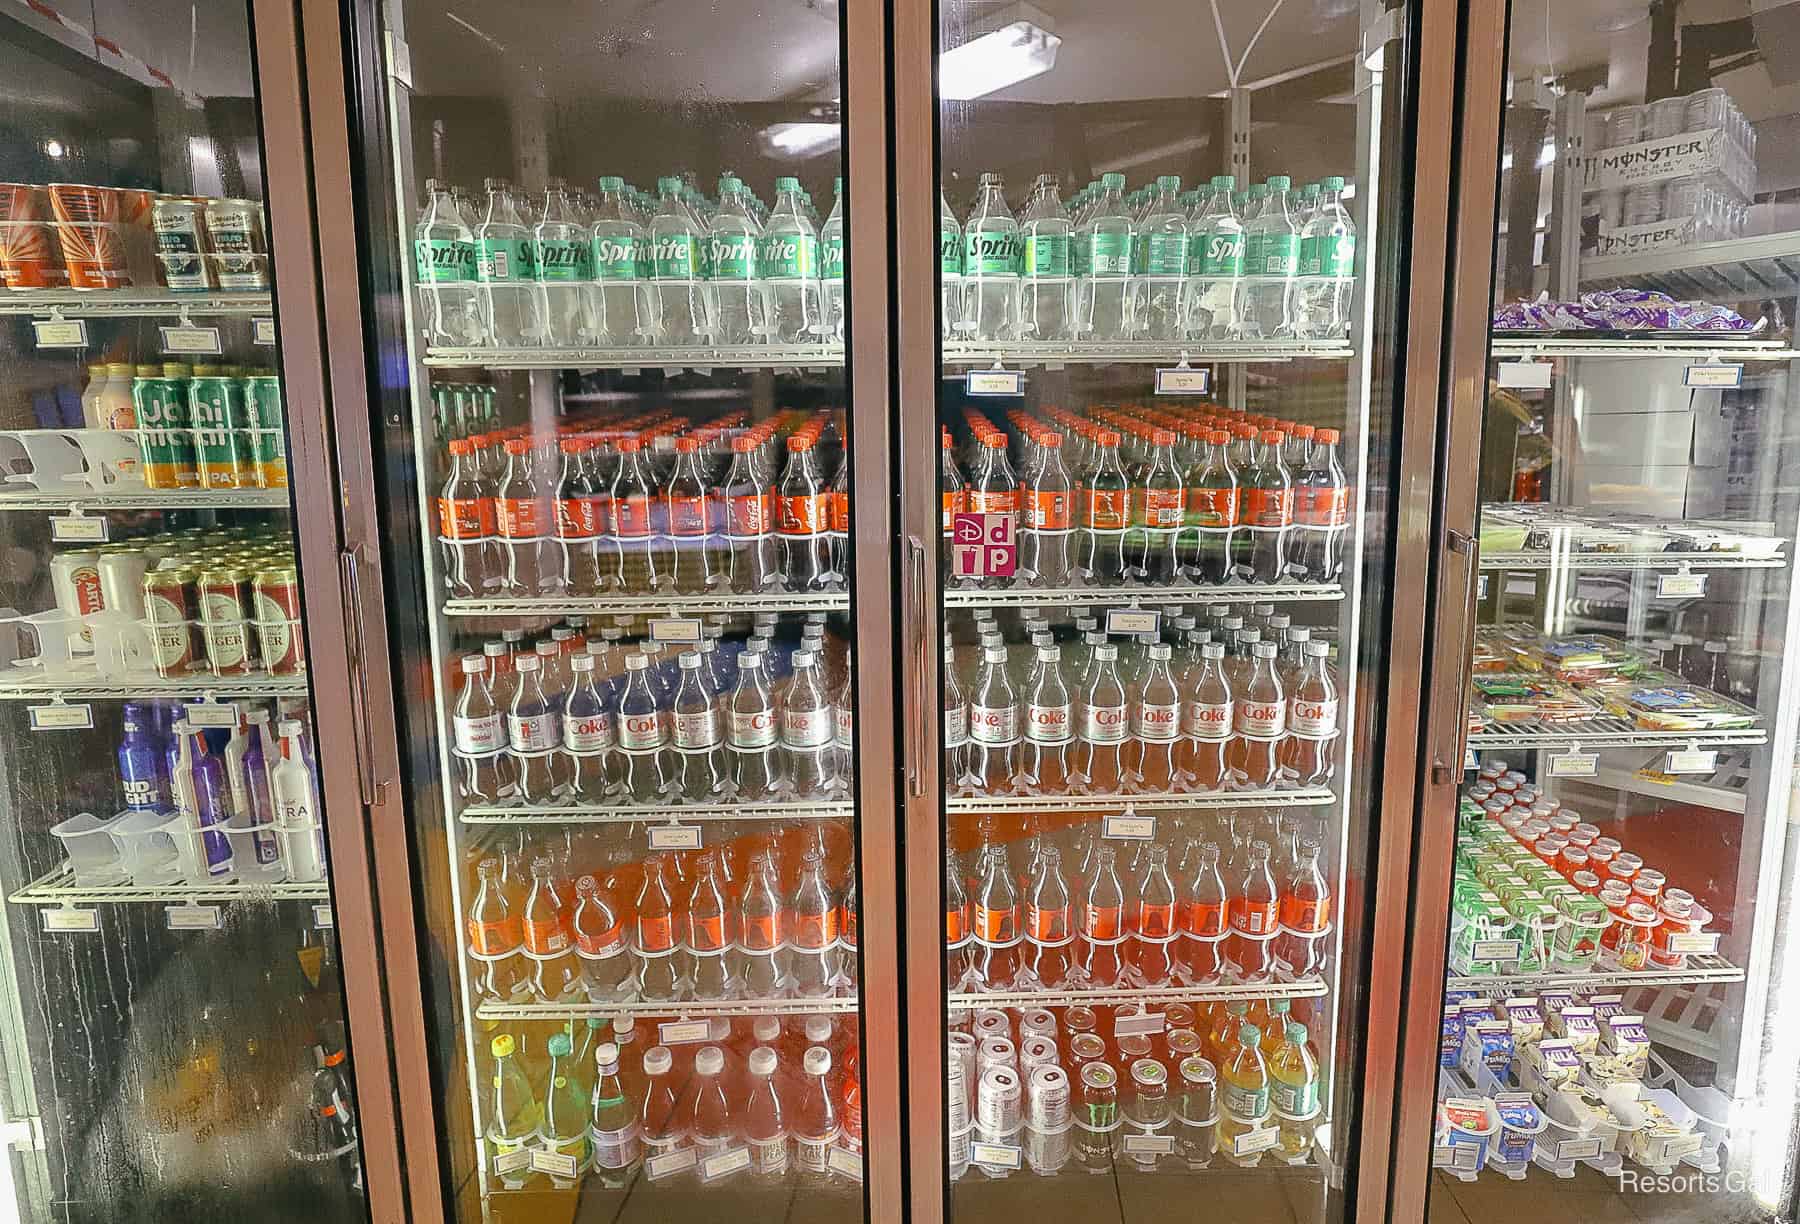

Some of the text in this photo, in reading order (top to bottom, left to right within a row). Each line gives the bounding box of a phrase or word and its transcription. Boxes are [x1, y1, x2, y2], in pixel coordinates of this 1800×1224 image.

[1603, 141, 1703, 168] MONSTER
[1136, 705, 1174, 723] Coke
[1510, 1007, 1541, 1019] MILK
[1595, 1006, 1626, 1017] MILK
[1567, 1018, 1598, 1030] MILK
[1616, 1027, 1648, 1039] MILK
[1545, 1050, 1577, 1063] MILK
